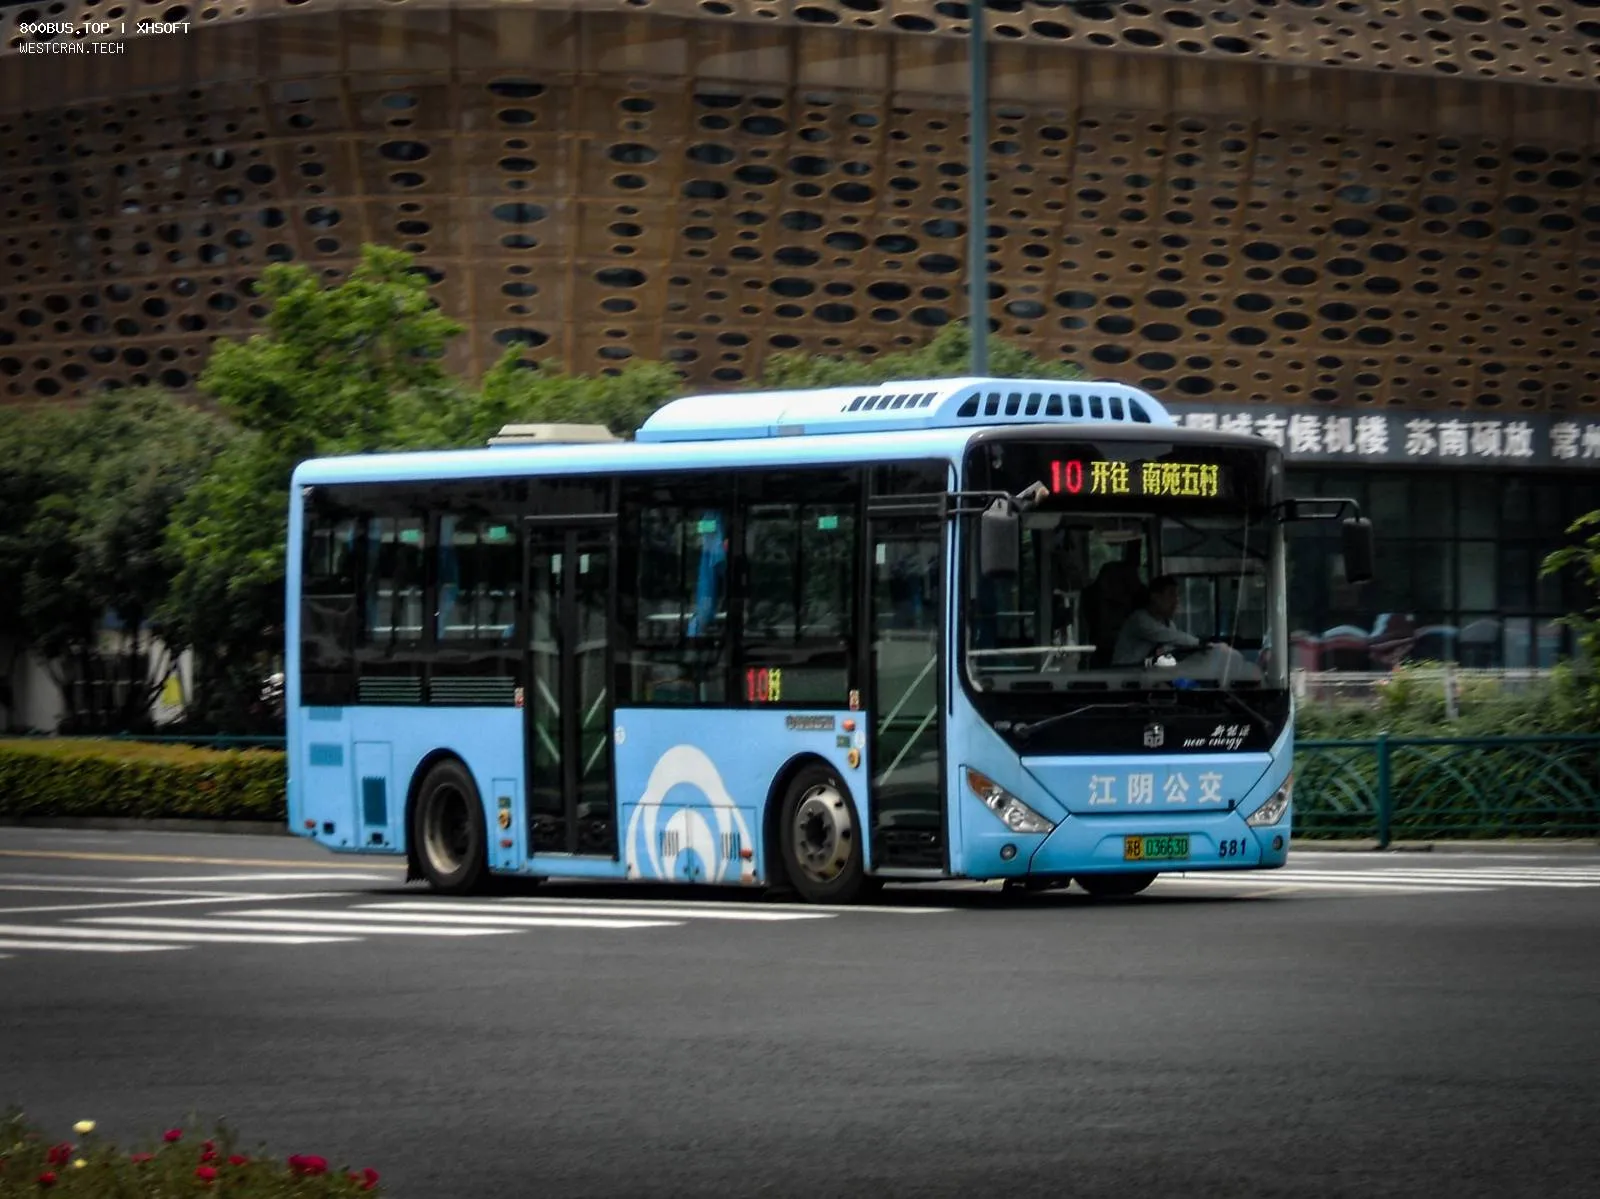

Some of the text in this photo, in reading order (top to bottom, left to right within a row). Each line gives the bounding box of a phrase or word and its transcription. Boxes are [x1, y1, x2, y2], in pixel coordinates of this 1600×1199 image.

[1405, 418, 1534, 457] 苏南硕放
[1051, 460, 1218, 496] 10 开往 南苑五村
[747, 667, 768, 701] 10
[1183, 738, 1242, 750] new energy
[1088, 772, 1223, 805] 江阴公交
[1219, 838, 1247, 857] 581
